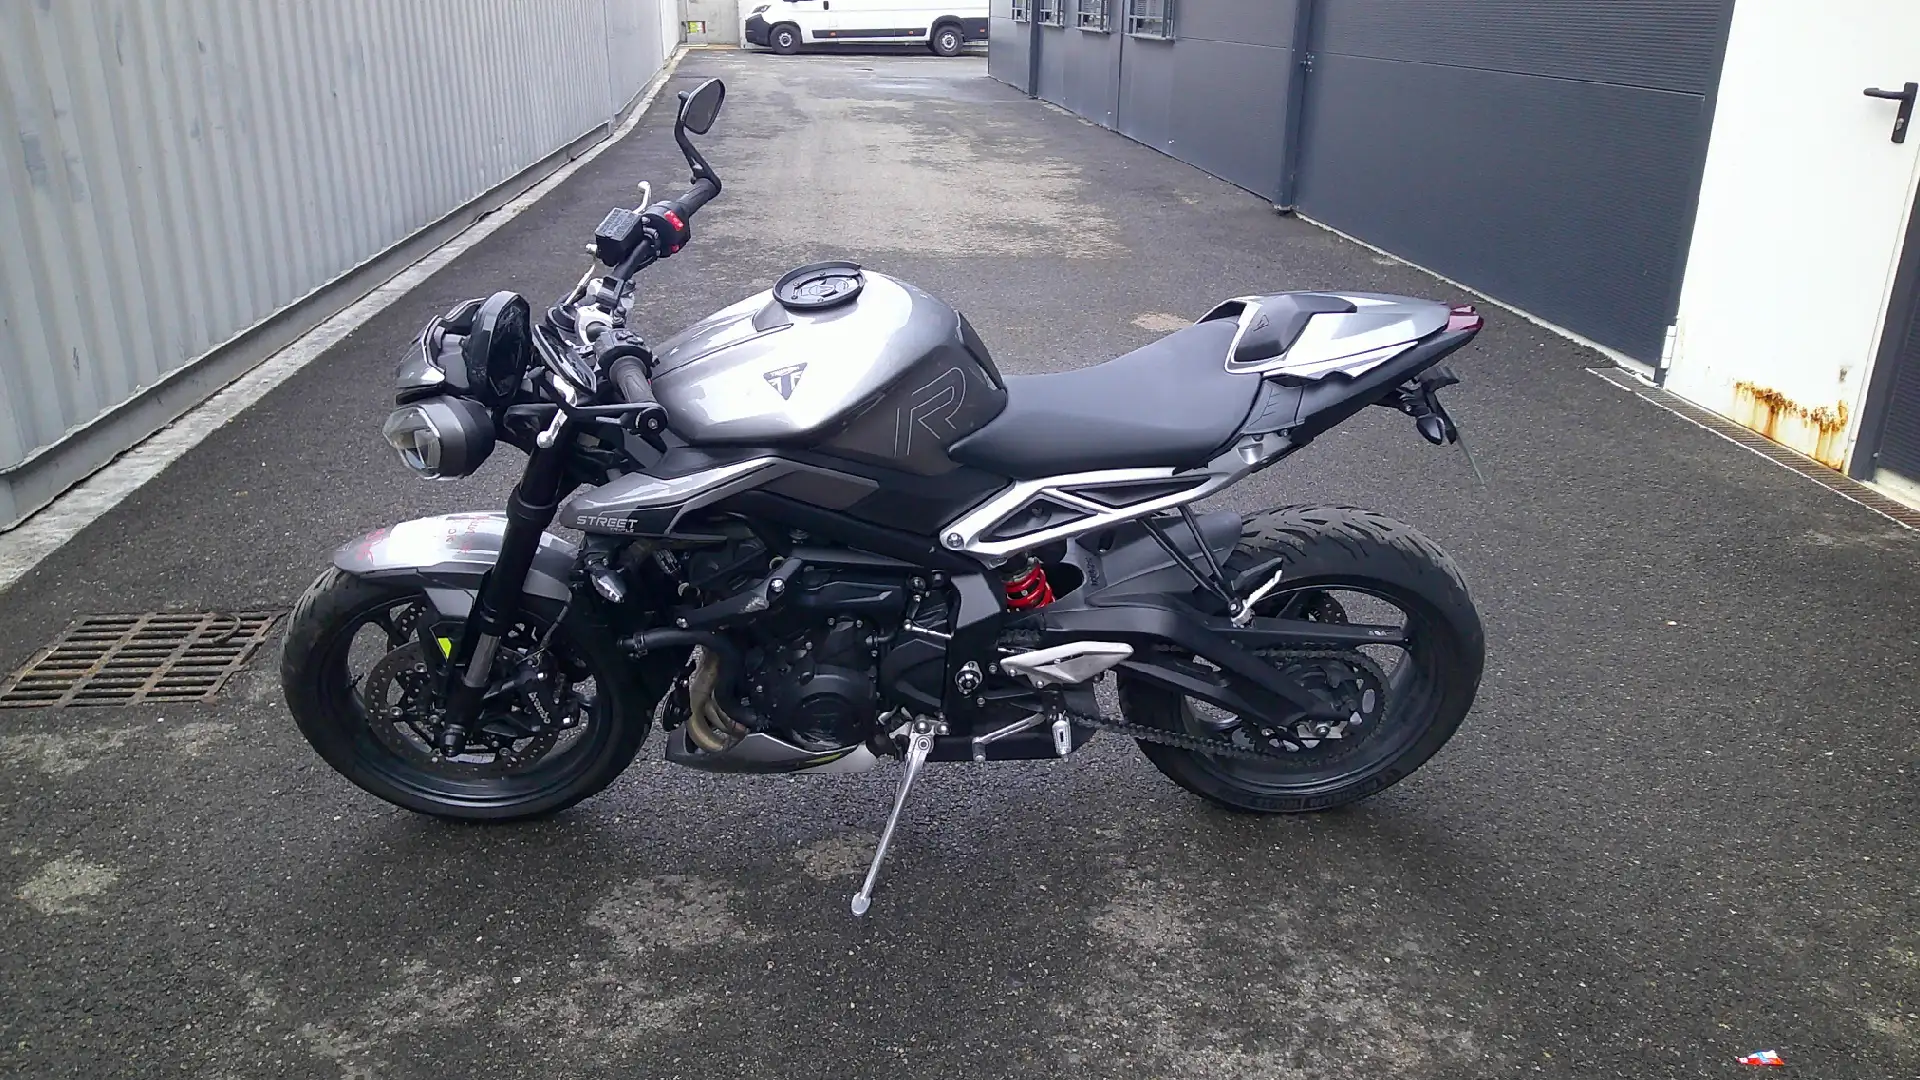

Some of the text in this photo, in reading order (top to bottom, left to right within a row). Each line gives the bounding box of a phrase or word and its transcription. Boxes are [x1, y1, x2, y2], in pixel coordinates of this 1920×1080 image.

[893, 366, 967, 457] R
[576, 515, 639, 529] STREET
[527, 691, 551, 724] brembo
